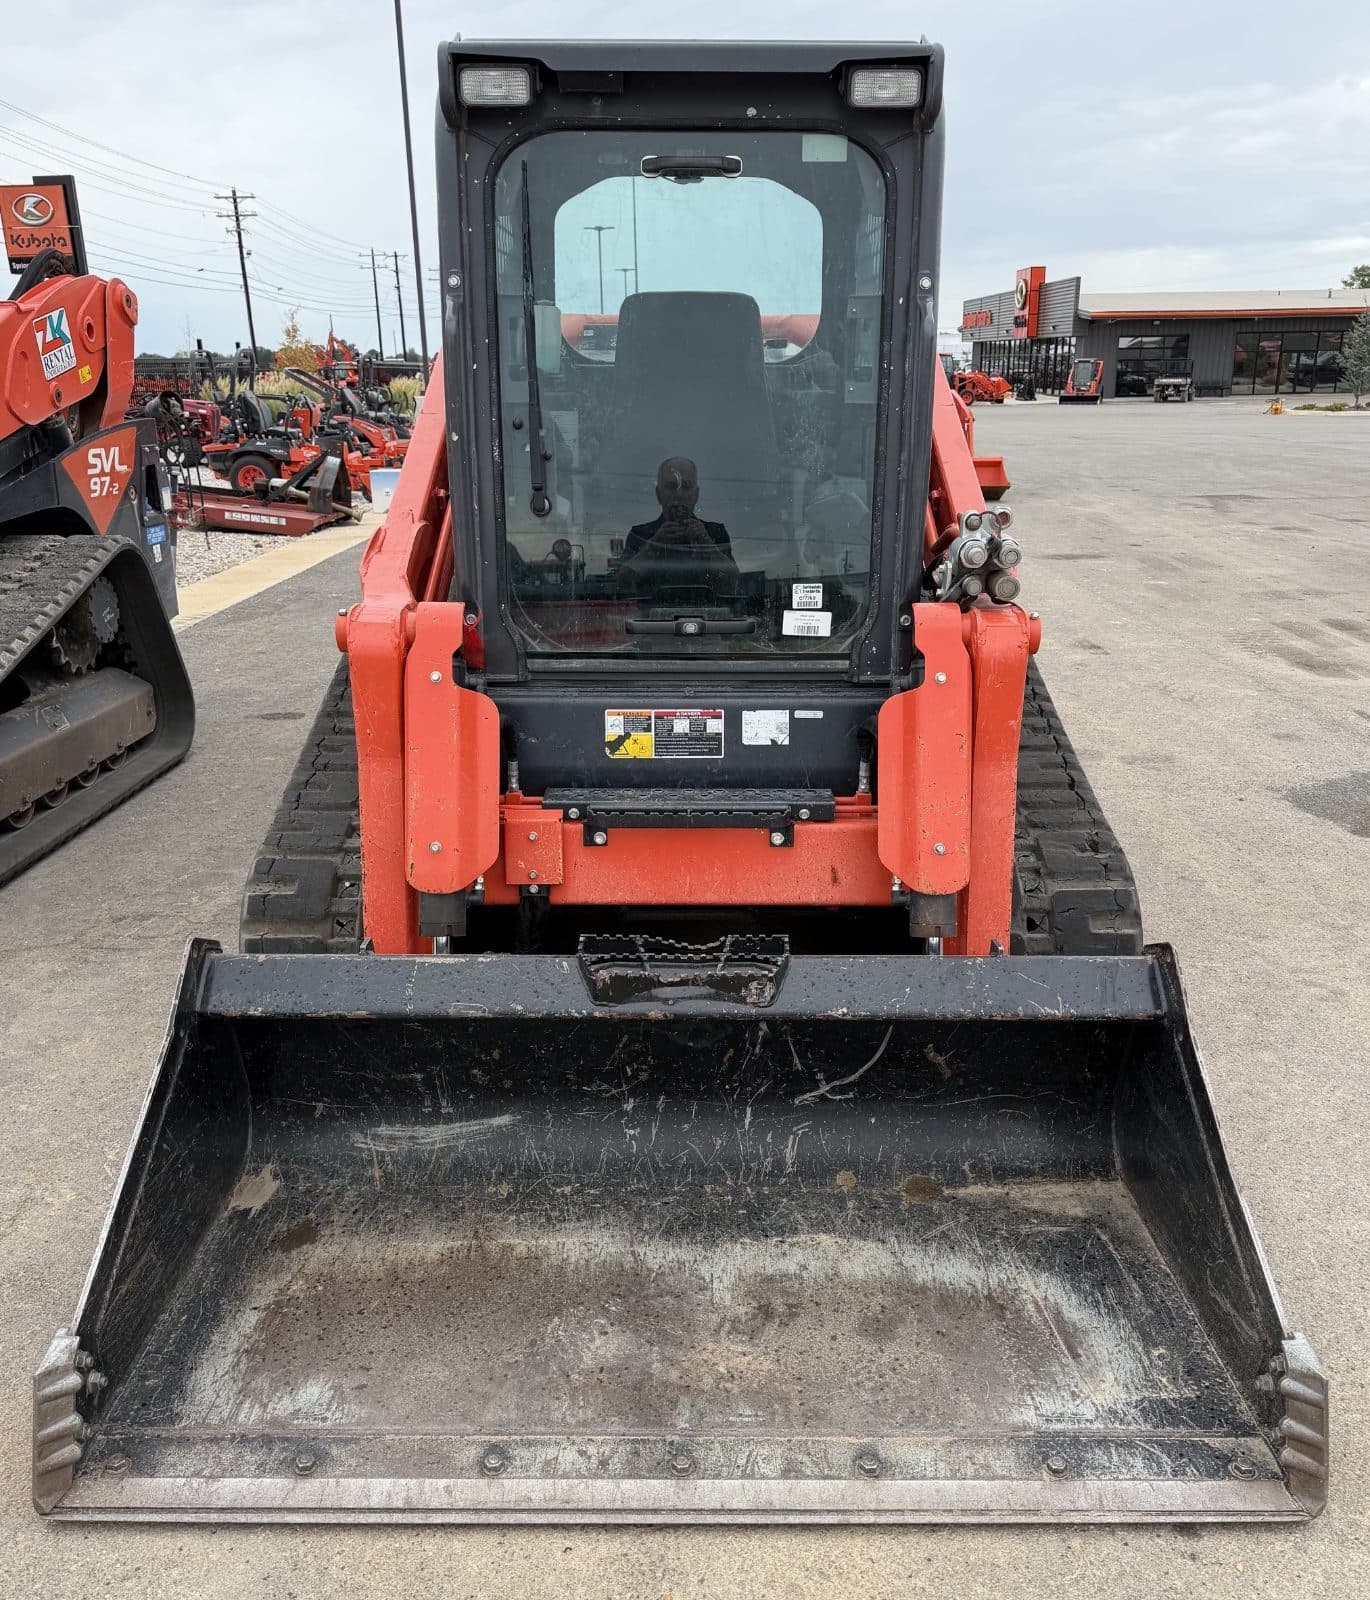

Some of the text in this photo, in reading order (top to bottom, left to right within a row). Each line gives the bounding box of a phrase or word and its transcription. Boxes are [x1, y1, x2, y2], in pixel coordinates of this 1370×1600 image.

[10, 233, 68, 249] Kubota
[43, 345, 75, 372] RENTAL
[87, 446, 128, 475] SVL
[90, 476, 120, 498] 97-2
